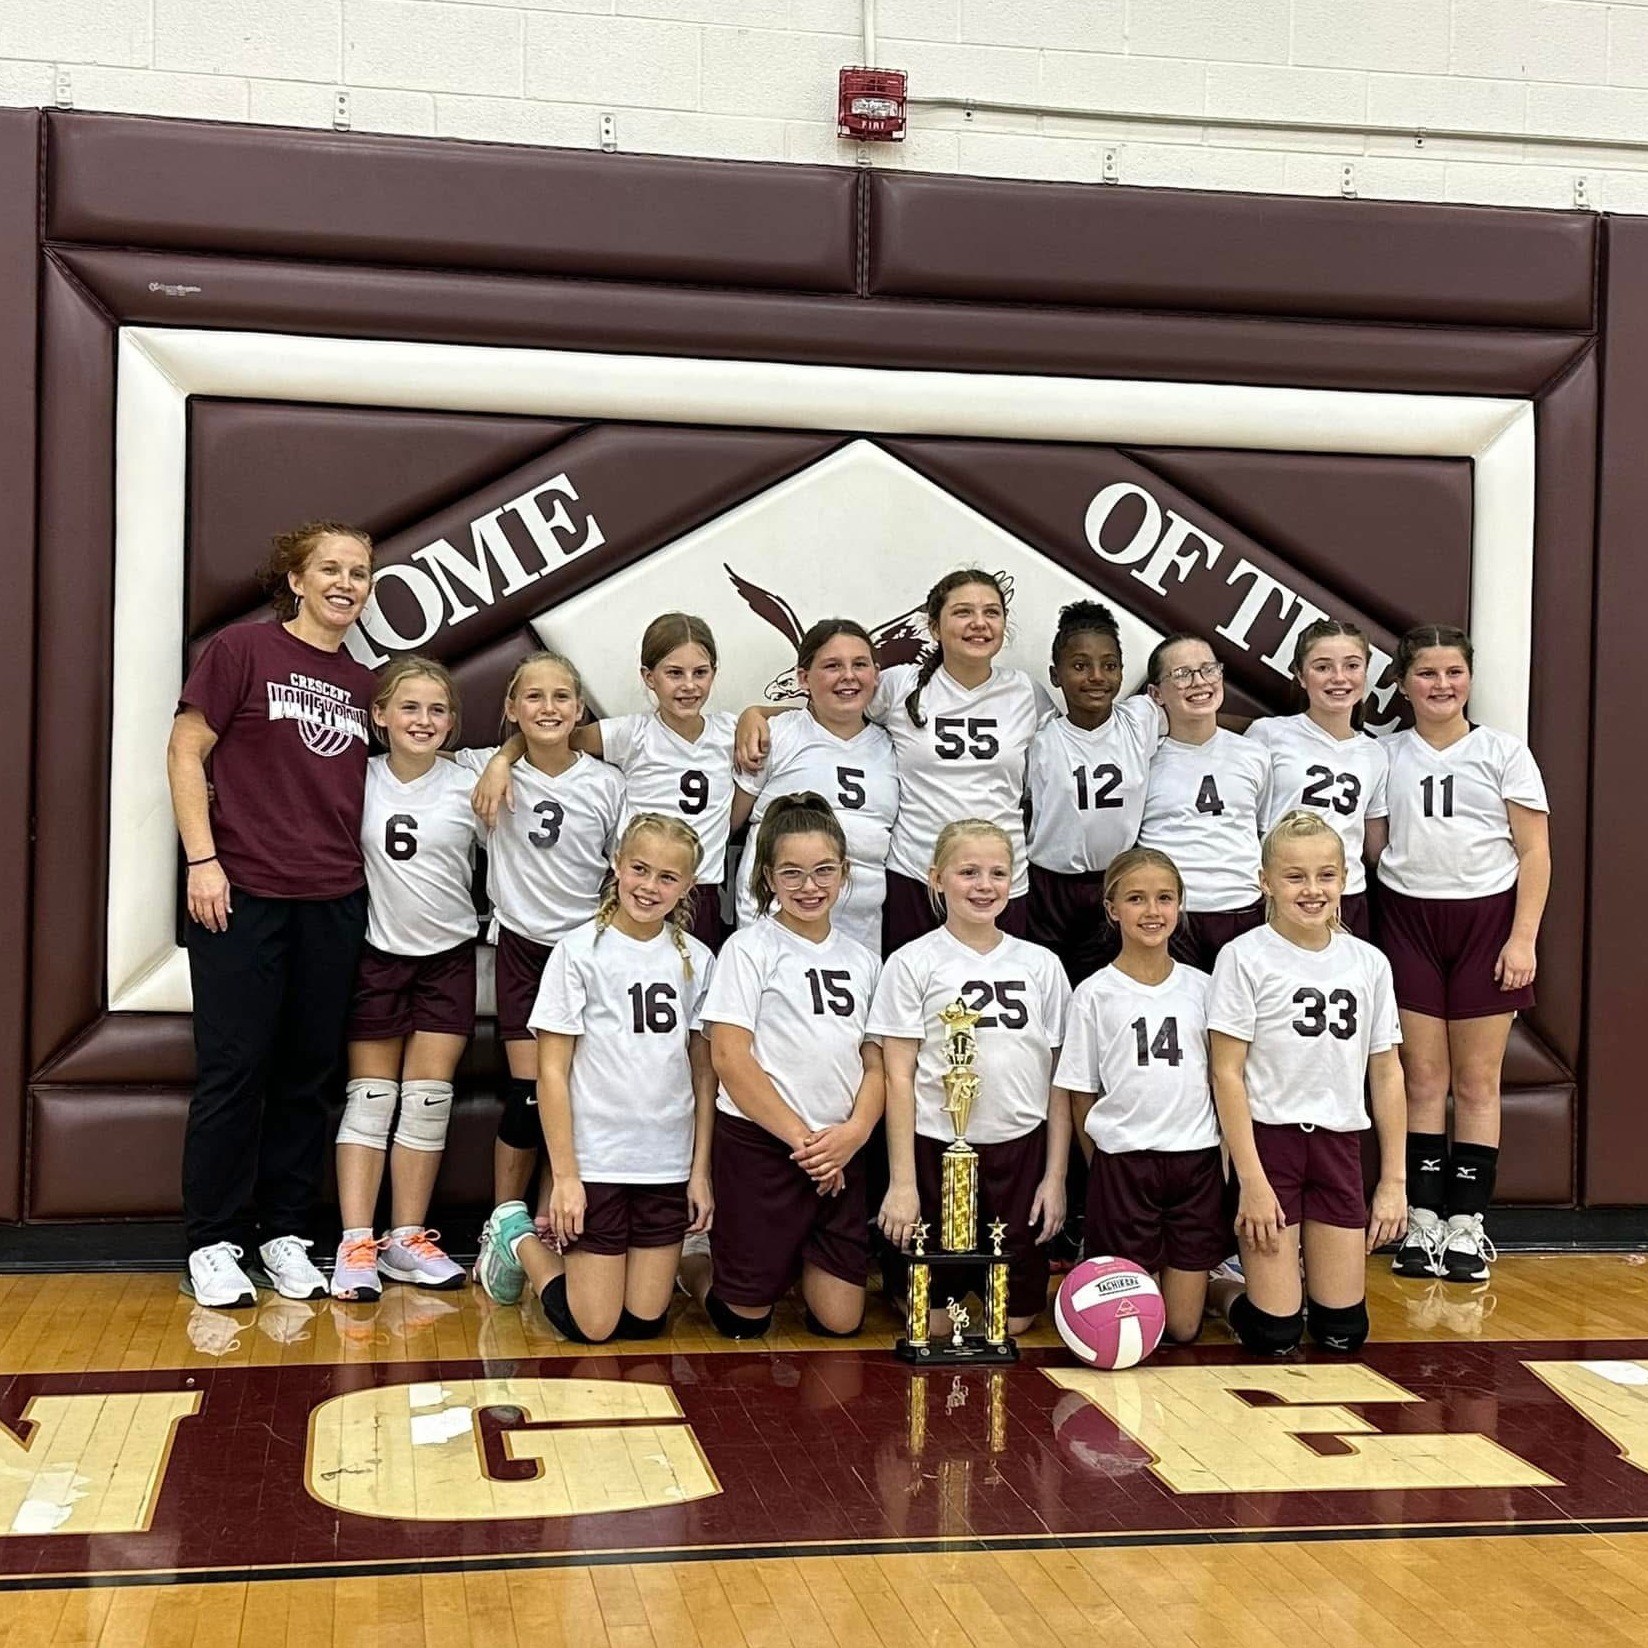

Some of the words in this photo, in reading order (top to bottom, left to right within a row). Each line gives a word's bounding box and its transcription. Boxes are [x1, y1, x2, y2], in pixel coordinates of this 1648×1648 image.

[1084, 482, 1225, 597] OF
[290, 672, 352, 704] CRESCENT
[934, 716, 1000, 760] 55
[678, 769, 709, 815] 9
[836, 766, 866, 810] 5
[1072, 763, 1124, 811] 12
[1195, 774, 1225, 816] 4
[1300, 764, 1362, 815] 23
[1419, 774, 1454, 818] 11
[385, 814, 418, 861] 6
[528, 800, 565, 849] 3
[627, 982, 678, 1034] 16
[804, 968, 855, 1017] 15
[961, 980, 1029, 1029] 25
[1292, 987, 1357, 1041] 33
[1131, 1016, 1184, 1067] 14
